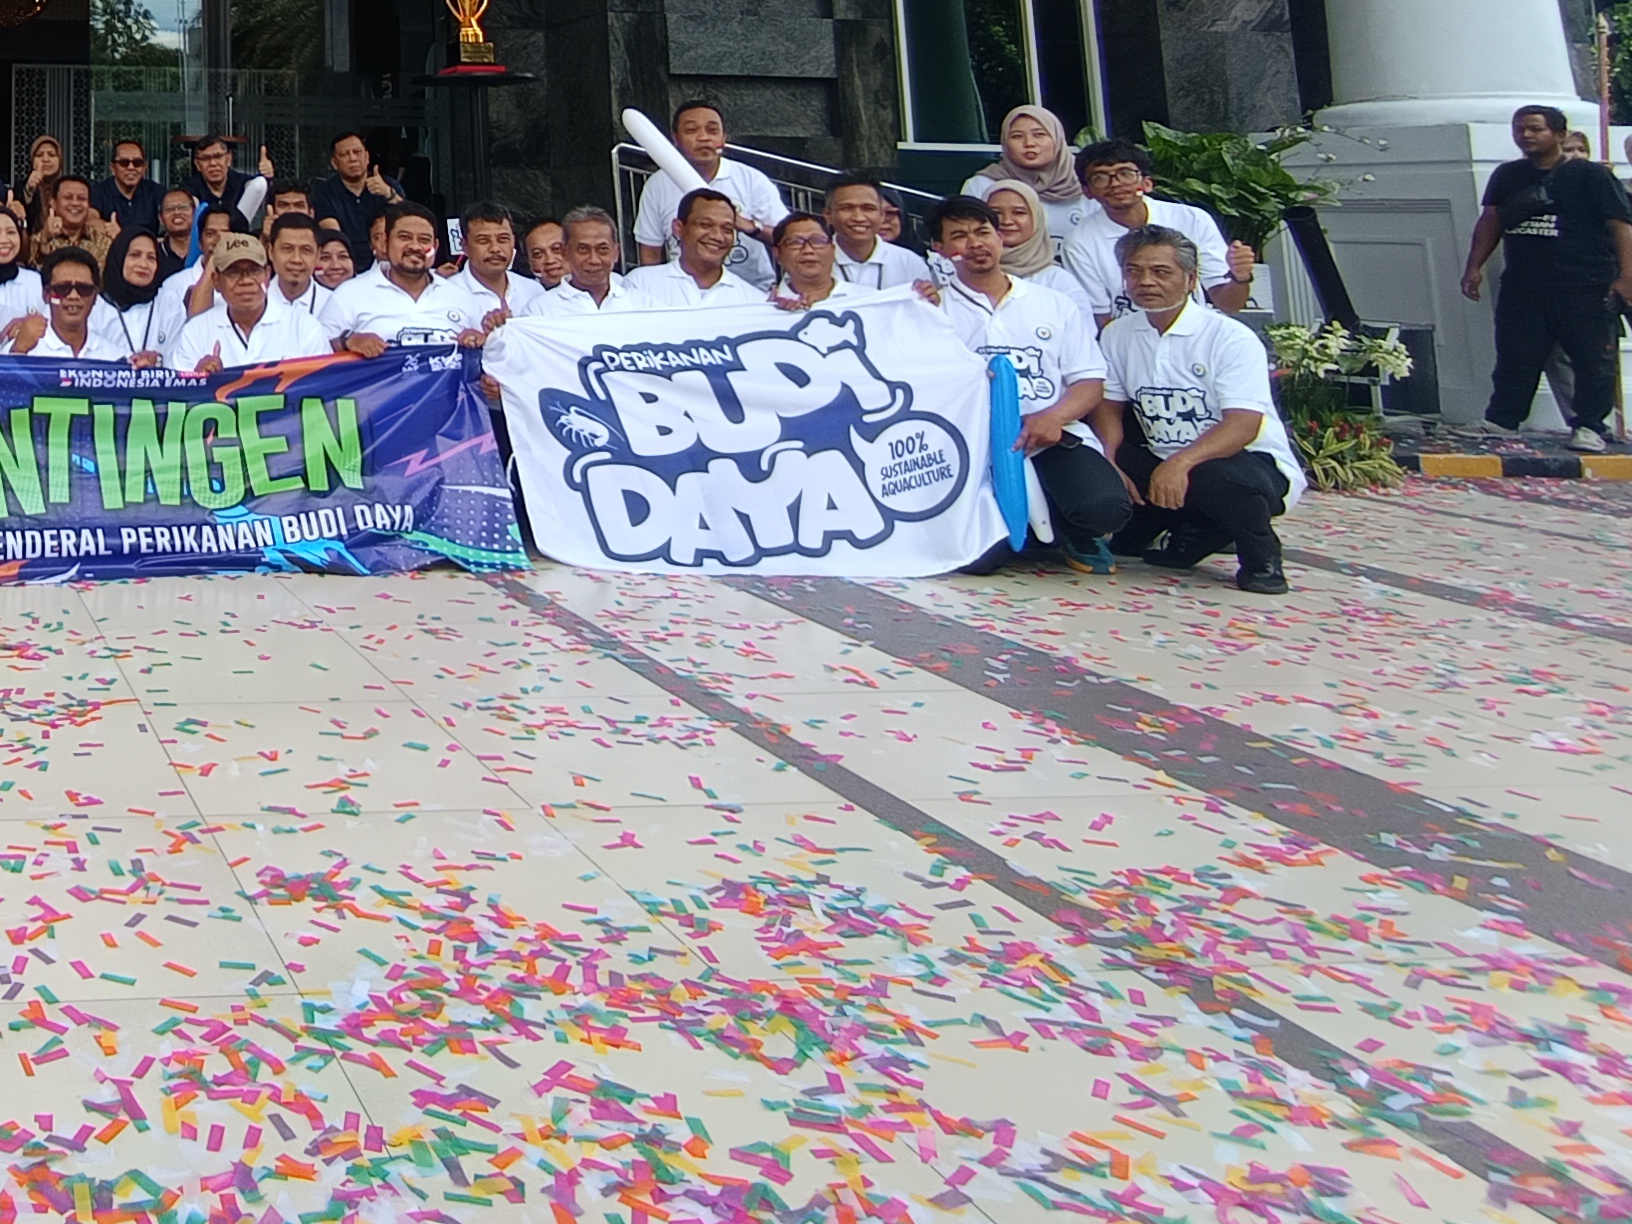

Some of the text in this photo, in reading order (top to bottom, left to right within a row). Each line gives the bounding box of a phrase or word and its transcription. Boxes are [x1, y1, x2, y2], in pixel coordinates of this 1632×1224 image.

[226, 239, 249, 251] Lee
[59, 368, 136, 380] EKONOMI
[140, 368, 176, 379] BIRU
[74, 377, 208, 388] INDONESIA EMAS
[888, 430, 929, 461] 100%
[879, 448, 946, 482] SUSTAINABLE
[880, 463, 954, 499] AQUACULTURE
[585, 448, 886, 565] DAYA
[121, 518, 278, 555] PERIKANAN
[283, 505, 348, 544] BUDI
[353, 502, 415, 532] DAYA
